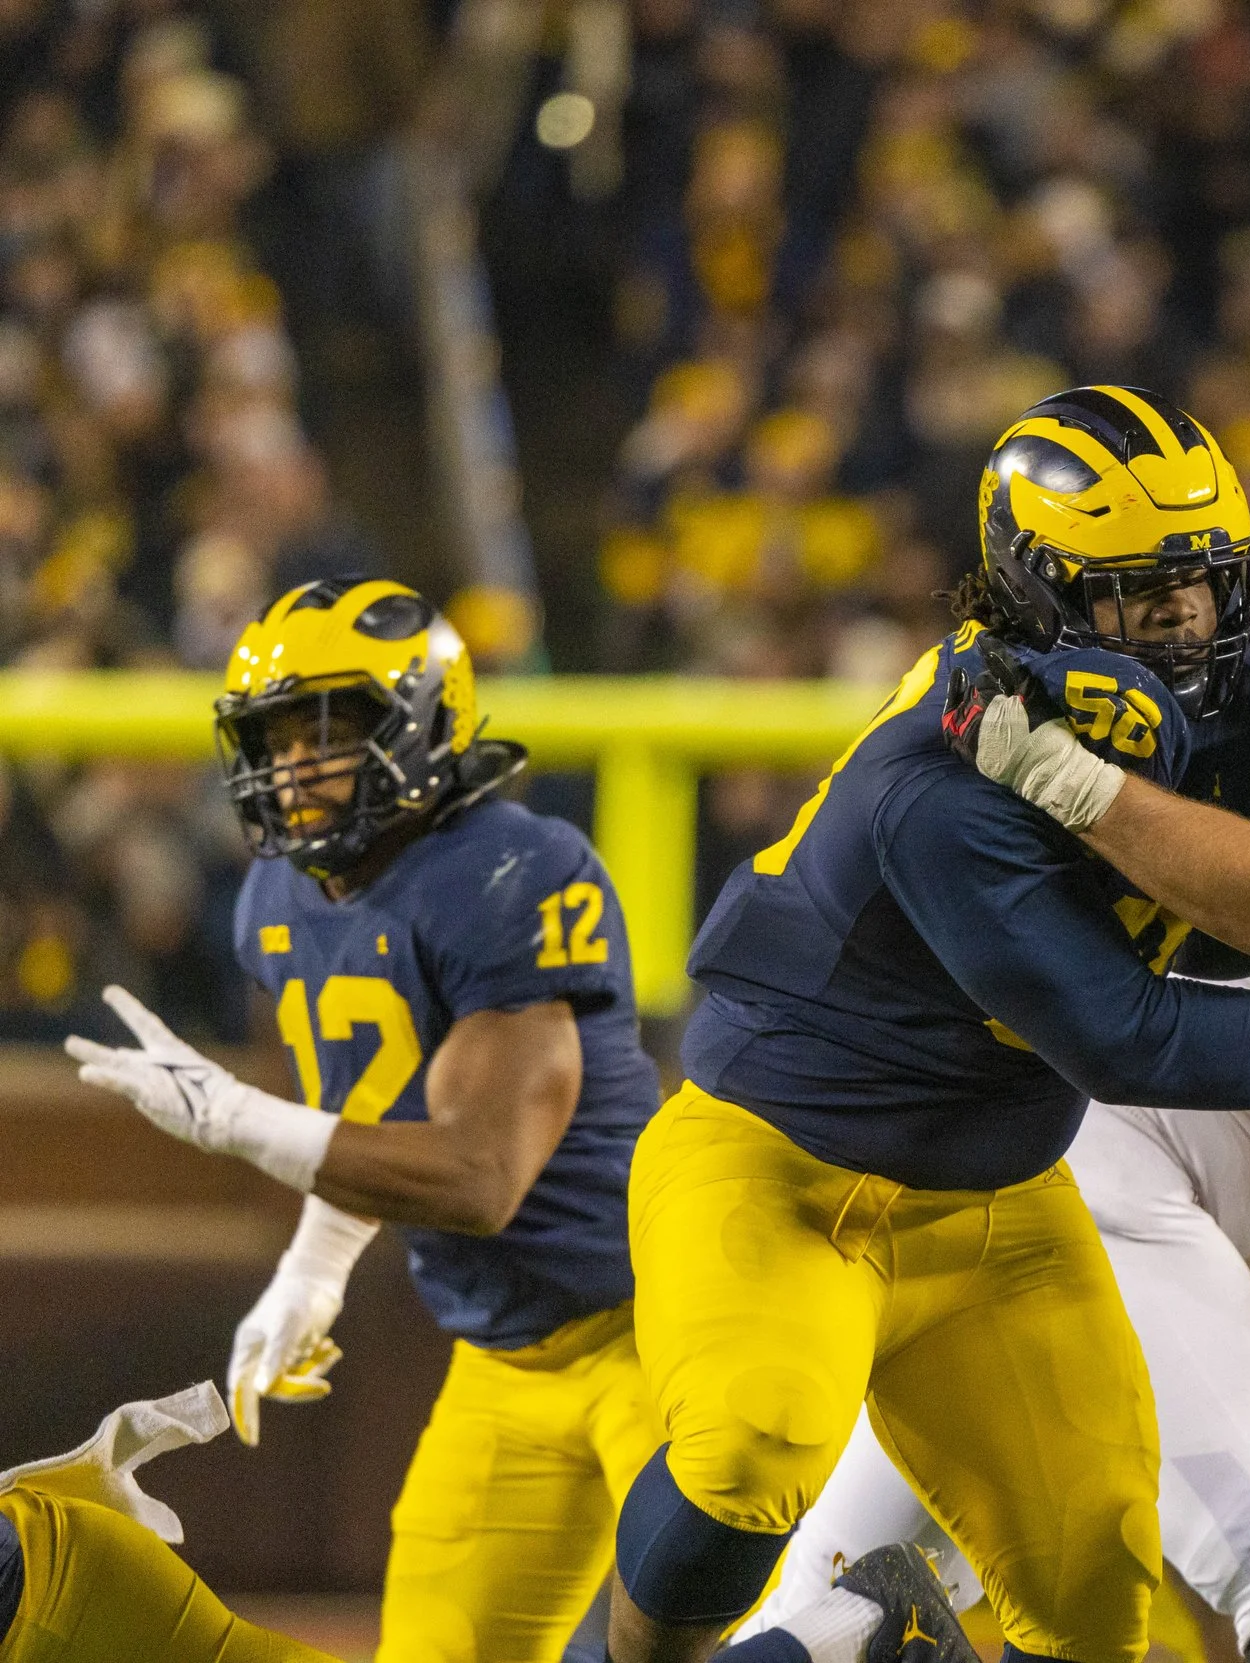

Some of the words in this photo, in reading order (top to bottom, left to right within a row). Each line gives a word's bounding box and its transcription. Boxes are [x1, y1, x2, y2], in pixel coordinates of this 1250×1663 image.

[1190, 533, 1211, 550] M
[535, 882, 609, 969] 12
[276, 974, 424, 1125] 12
